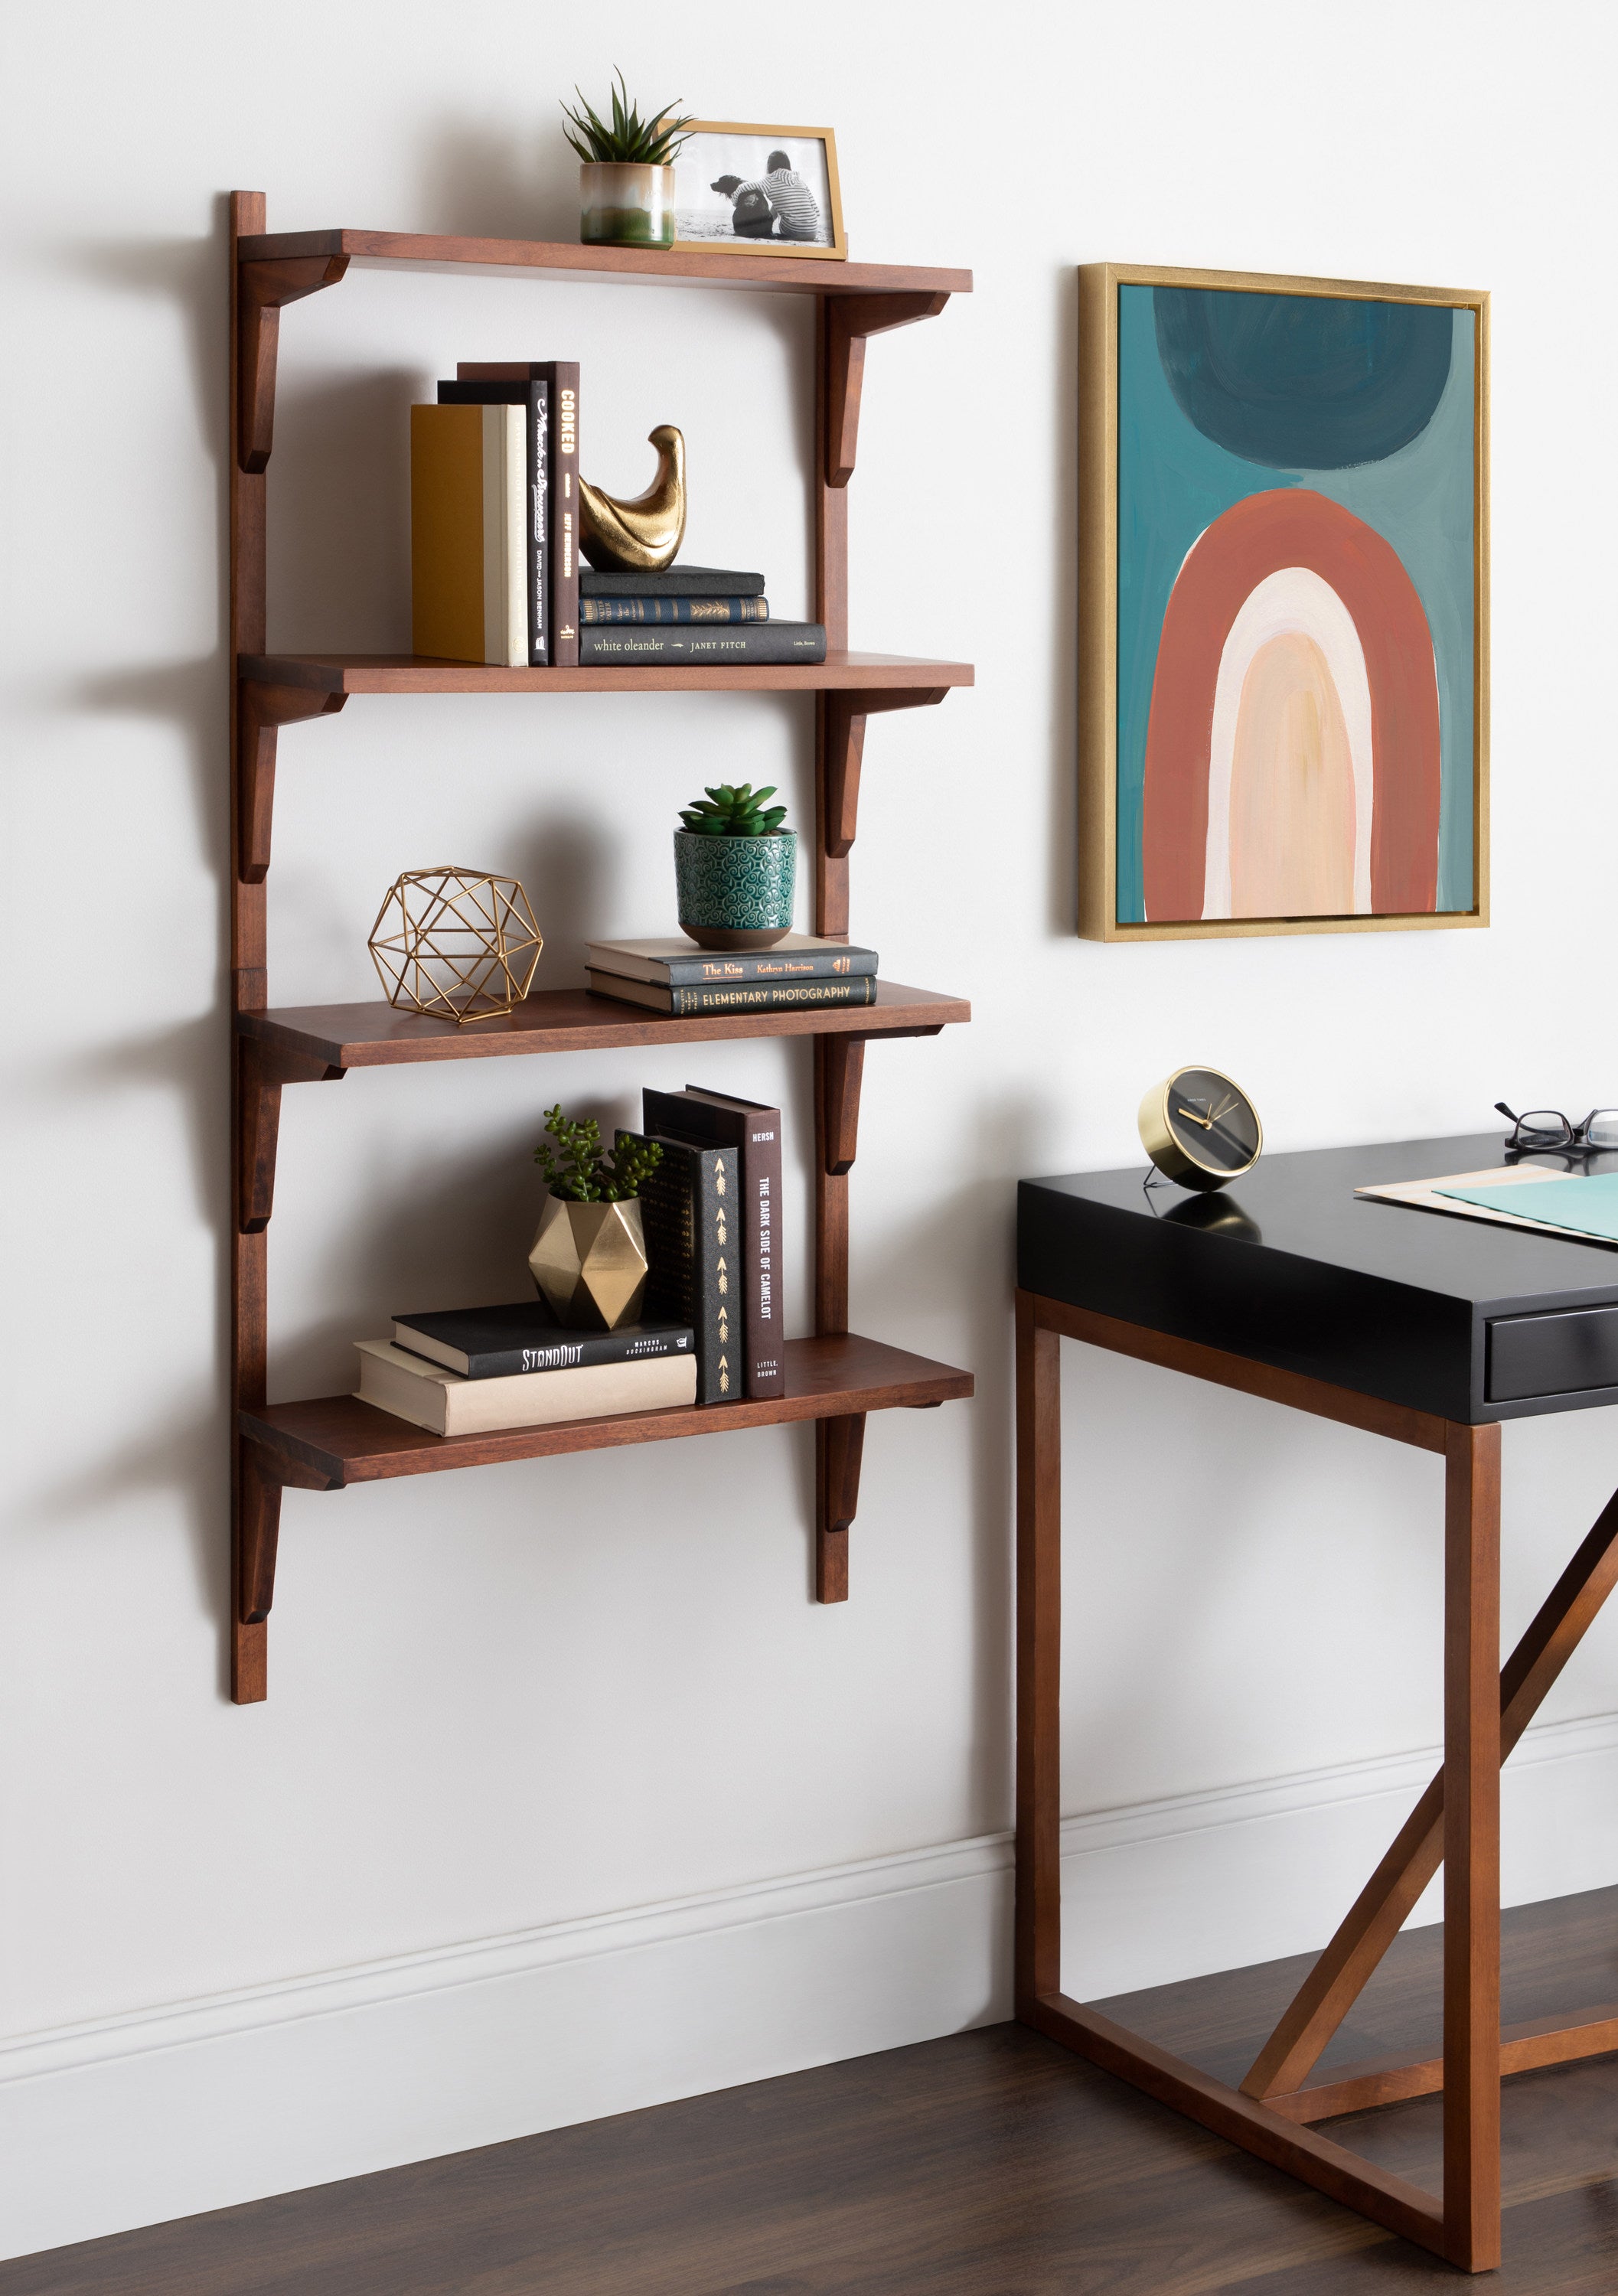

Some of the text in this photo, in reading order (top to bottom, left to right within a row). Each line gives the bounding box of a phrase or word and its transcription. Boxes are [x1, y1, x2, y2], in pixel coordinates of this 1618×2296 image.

[561, 390, 574, 454] COOKED
[537, 398, 547, 459] Miracle
[594, 639, 622, 651] white
[624, 638, 664, 651] oleander
[690, 641, 717, 652] JANET
[703, 963, 743, 975] The Kiss
[757, 963, 814, 974] Kathryn Harrison
[703, 986, 850, 1006] ELEMENTARY PHOTOGRAPHY
[752, 1132, 774, 1142] HERSH
[759, 1177, 771, 1319] THE DARK SIDE OF CAMELOT
[634, 1339, 659, 1347] MARCUS
[626, 1345, 667, 1355] BUCKINGHAM
[757, 1360, 778, 1368] LITTLE,
[757, 1369, 777, 1378] BROWN
